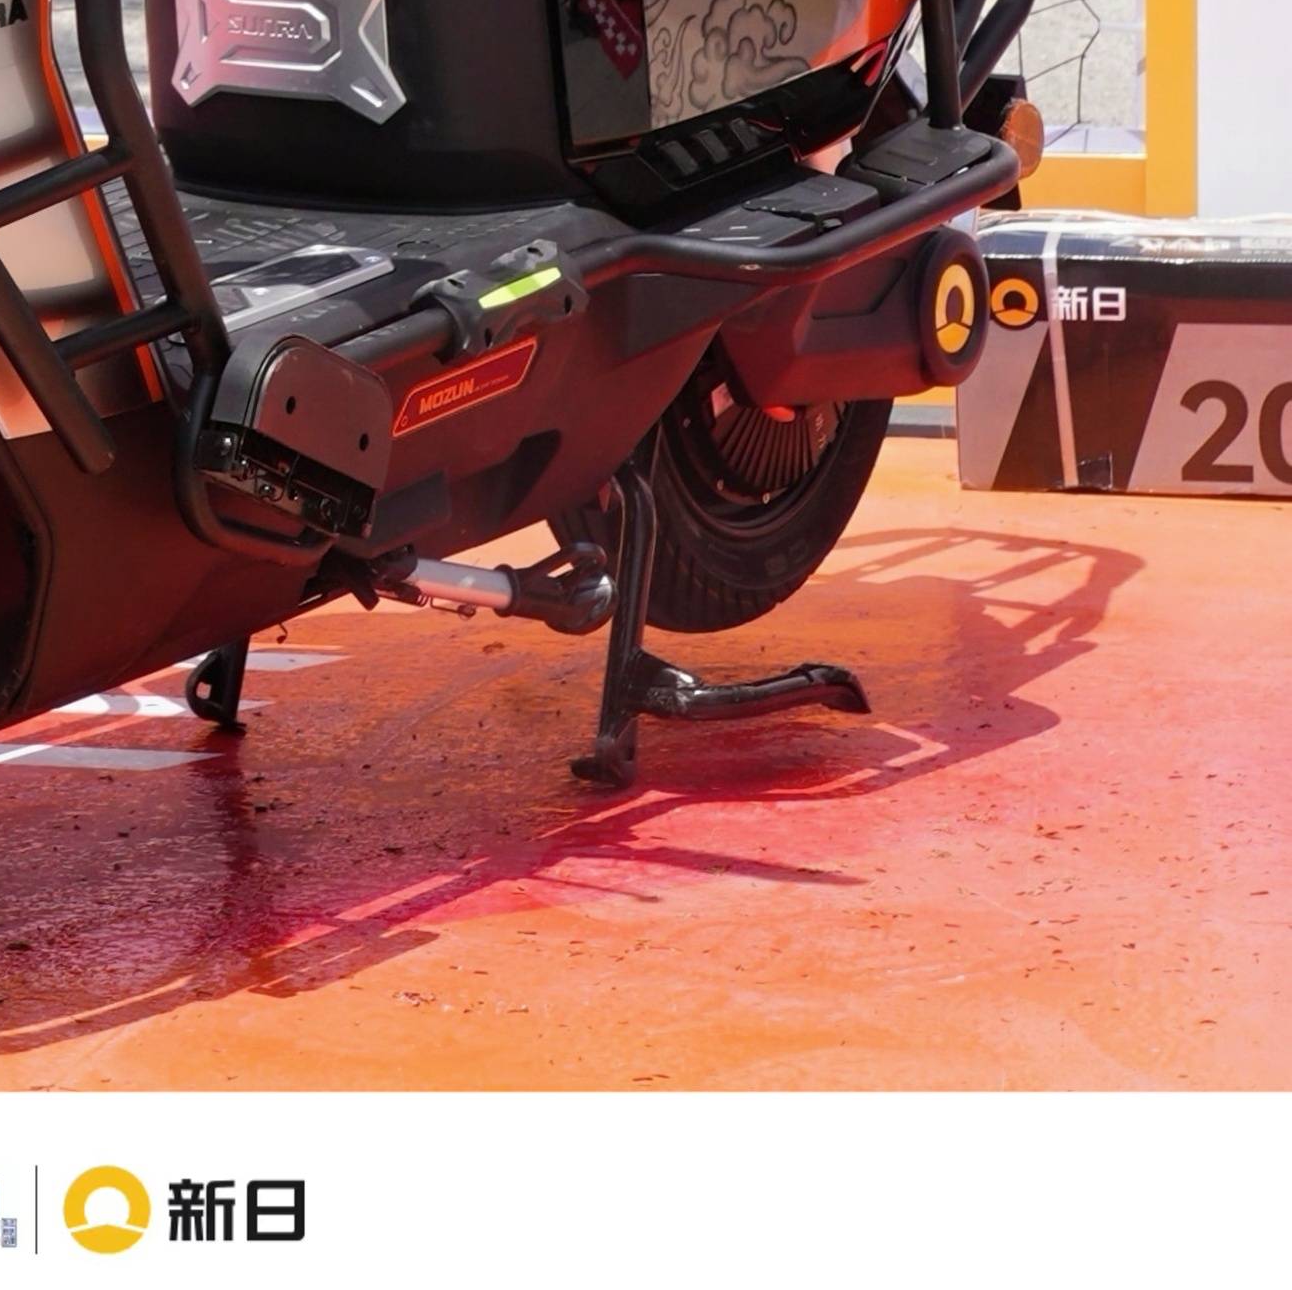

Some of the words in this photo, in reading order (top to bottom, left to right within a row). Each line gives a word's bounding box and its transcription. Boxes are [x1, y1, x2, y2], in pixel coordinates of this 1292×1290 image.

[228, 16, 313, 40] SUNRA
[1054, 286, 1126, 322] 新日
[419, 378, 475, 415] MOZUN
